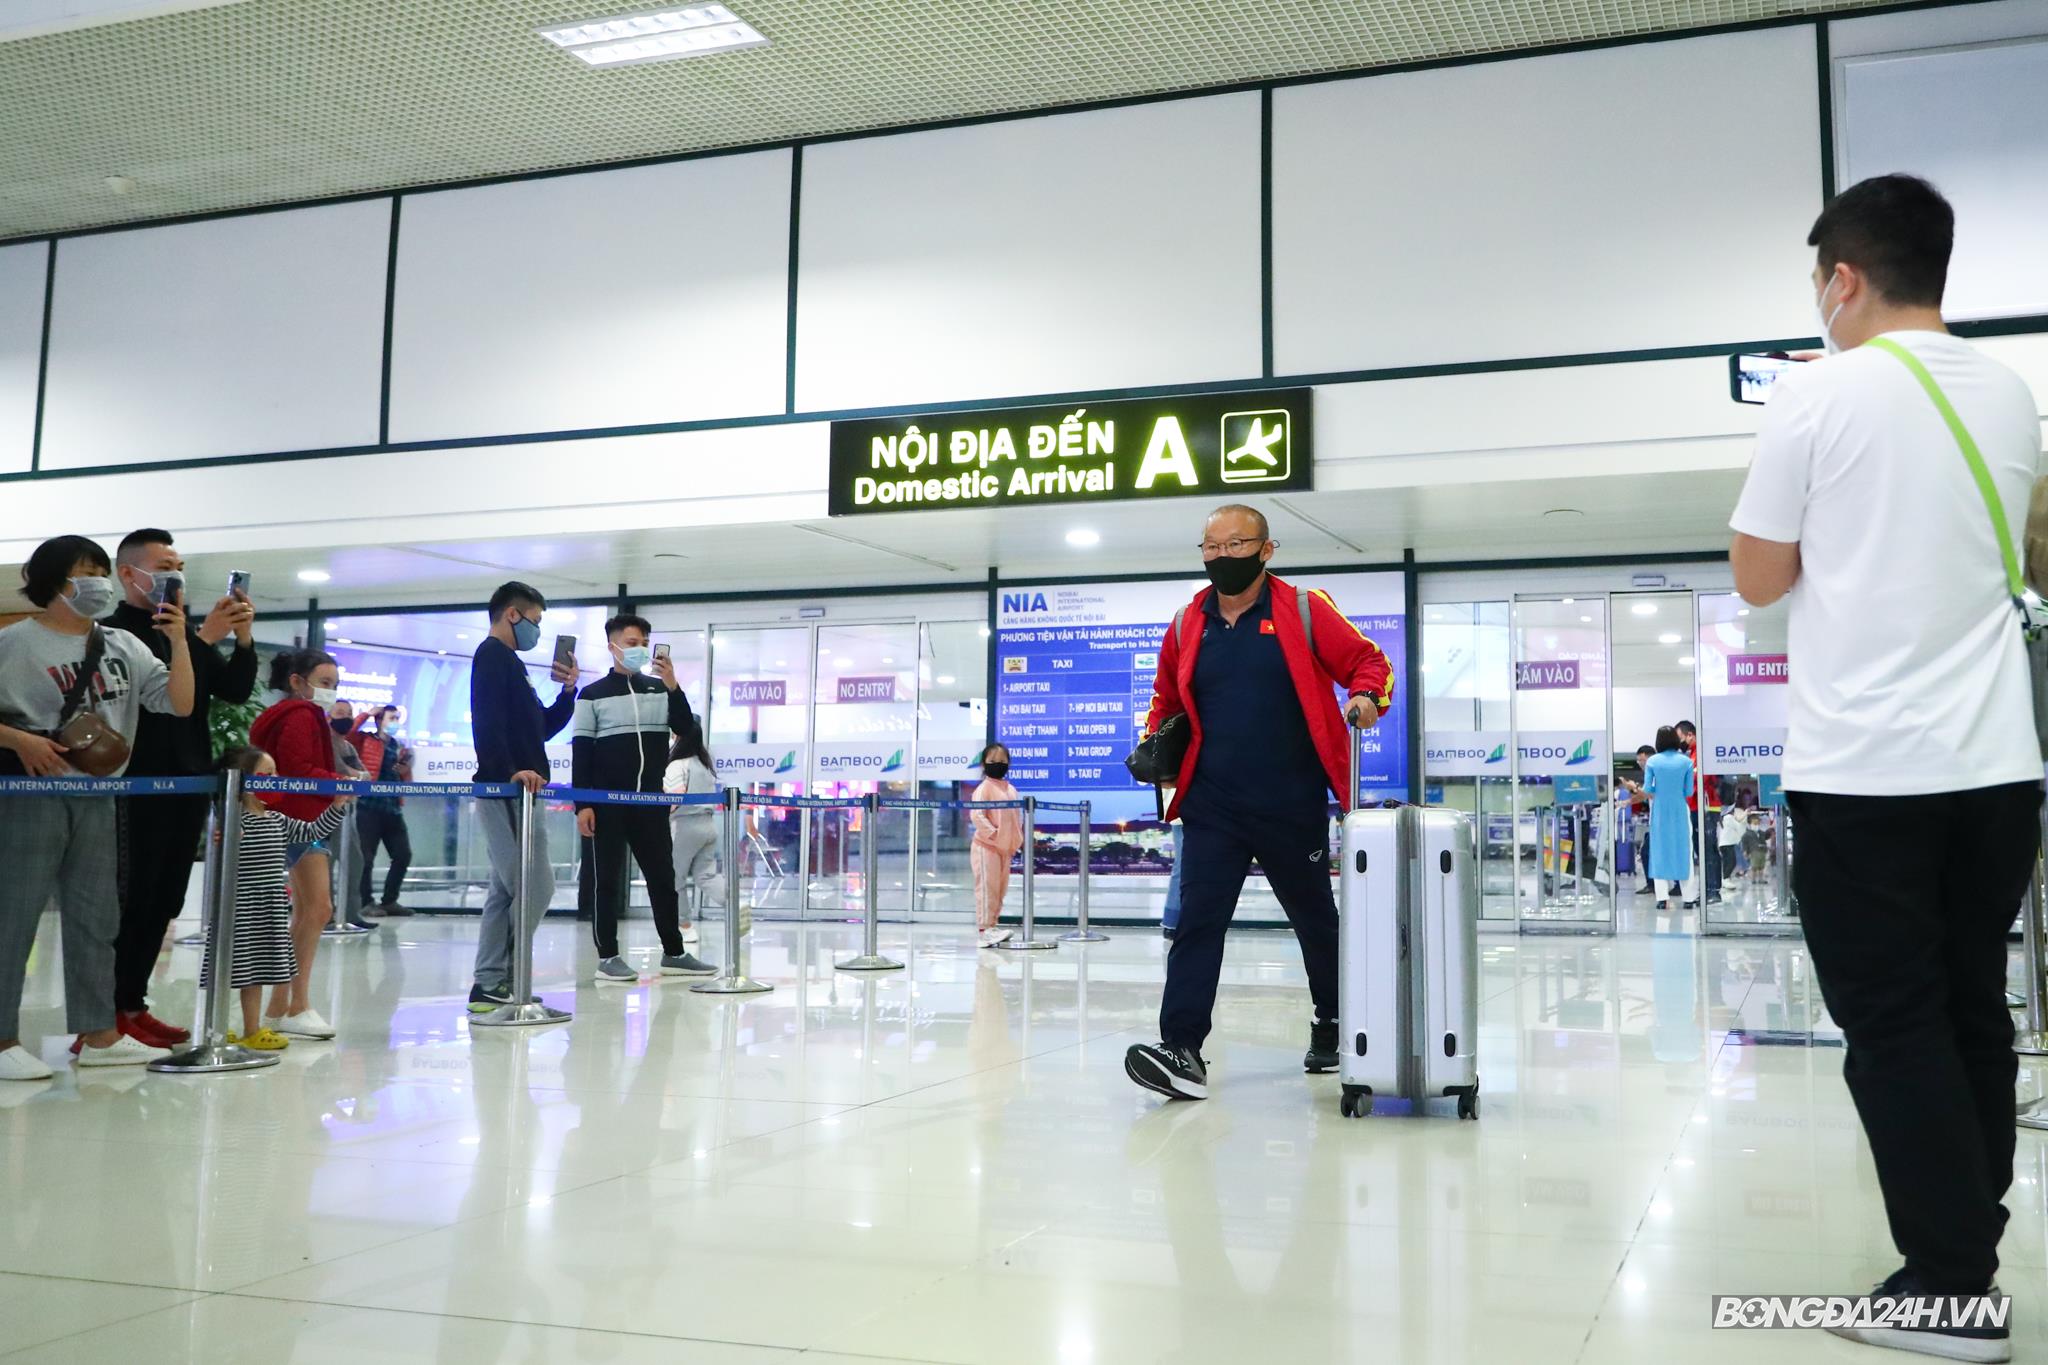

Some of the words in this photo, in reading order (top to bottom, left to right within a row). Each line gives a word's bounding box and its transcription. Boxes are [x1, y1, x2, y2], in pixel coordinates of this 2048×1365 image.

[871, 426, 938, 474] NỘI
[950, 428, 1017, 469] ĐỊA
[1028, 408, 1115, 458] ĐẾN
[1134, 416, 1199, 489] A
[854, 468, 999, 505] Domestic
[1007, 462, 1114, 497] Arrival
[1003, 593, 1048, 613] NIA
[1000, 632, 1035, 643] PHƯƠNG
[1037, 629, 1055, 643] TIỆN
[1056, 629, 1074, 642] VẬN
[1115, 626, 1145, 639] KHÁCH
[1147, 625, 1169, 638] CÔN
[1374, 617, 1398, 630] THÁC
[1088, 641, 1127, 651] Transport
[1128, 641, 1137, 649] to
[1139, 640, 1150, 648] Ha
[1151, 640, 1162, 648] No
[1052, 659, 1073, 669] TAXI
[1735, 662, 1754, 676] NO
[1758, 662, 1789, 676] ENTR
[1545, 663, 1575, 683] VÀO
[733, 682, 757, 701] CẤM
[759, 682, 782, 700] VÀO
[840, 683, 855, 698] NO
[857, 682, 891, 697] ENTRY
[1036, 682, 1050, 692] TAXI
[1032, 704, 1046, 714] TAXI
[1109, 701, 1123, 712] TAXI
[1009, 726, 1022, 736] TAXI
[1076, 724, 1089, 735] TAXI
[1008, 747, 1022, 757] TAXI
[1075, 746, 1089, 756] TAXI
[1090, 746, 1112, 756] GROUP
[1426, 749, 1486, 759] BAMBOO
[1517, 747, 1567, 759] MBOO
[1715, 745, 1784, 758] BAMBO
[716, 757, 776, 769] BAMBOO
[820, 756, 882, 767] BAMBOO
[918, 755, 968, 765] BAMBOO
[1008, 769, 1022, 779] TAXI
[1078, 768, 1092, 778] TAXI
[1360, 774, 1388, 782] erminal
[9, 781, 89, 791] INTERNATIONAL
[91, 781, 131, 791] AIRPORT
[252, 778, 276, 790] QUỐC
[278, 778, 287, 790] TẾ
[289, 780, 304, 792] NỘI
[395, 784, 446, 794] INTERNATIONAL
[447, 785, 473, 794] AIRPORT
[631, 794, 657, 802] AVIATION
[658, 795, 684, 803] SECURITY
